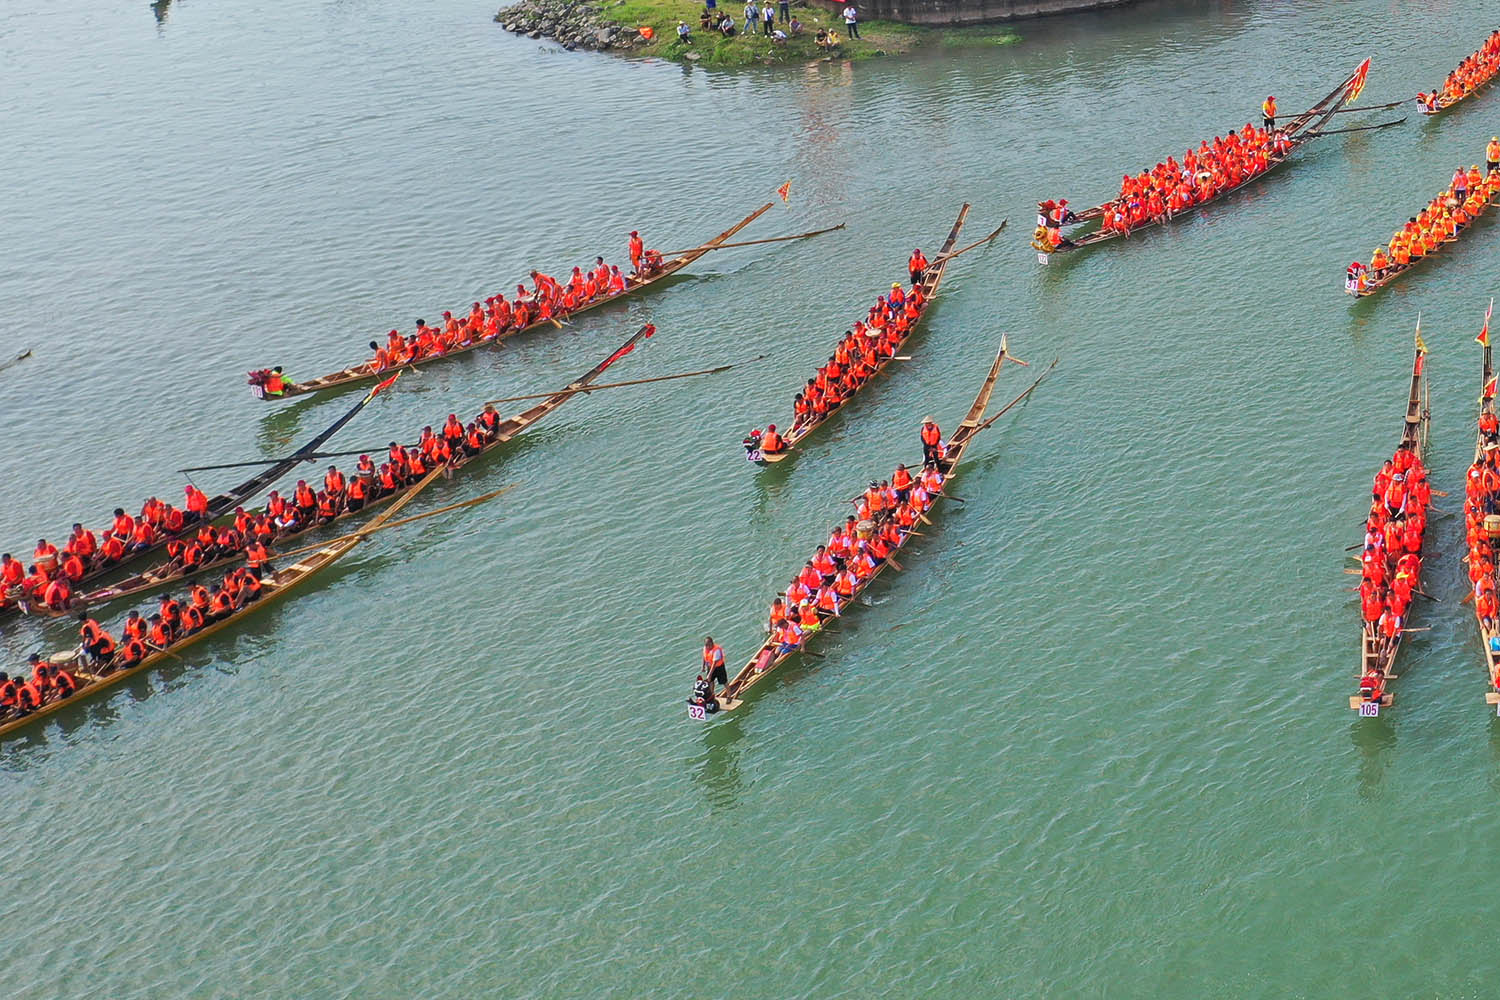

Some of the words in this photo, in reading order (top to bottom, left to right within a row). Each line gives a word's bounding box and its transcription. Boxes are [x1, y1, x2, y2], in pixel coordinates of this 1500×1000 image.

[747, 450, 760, 460] 22
[689, 706, 705, 720] 32
[1360, 704, 1377, 716] 105
